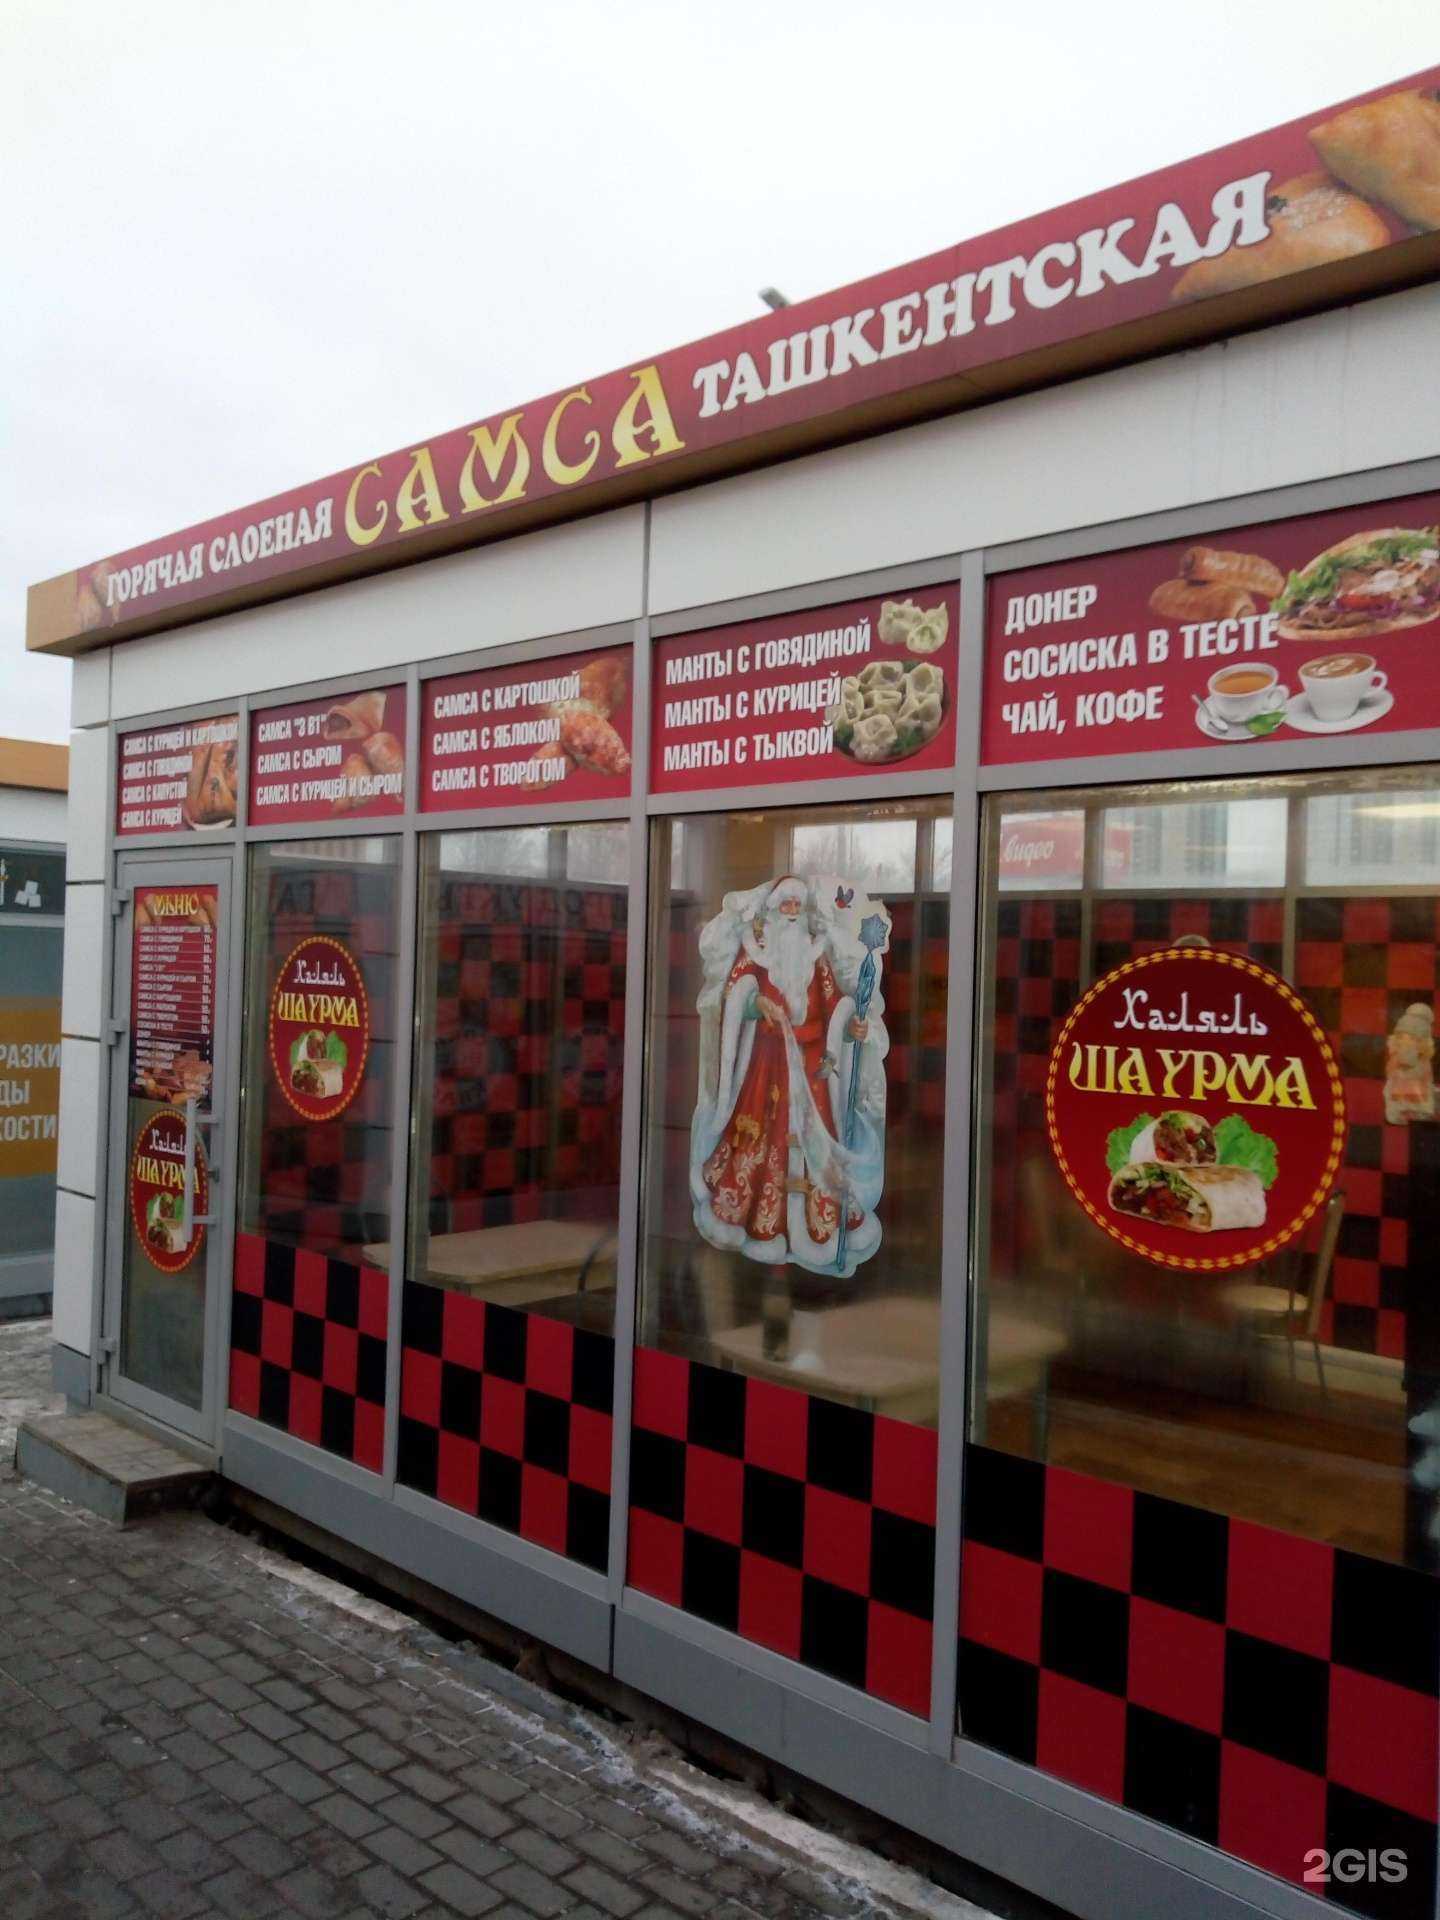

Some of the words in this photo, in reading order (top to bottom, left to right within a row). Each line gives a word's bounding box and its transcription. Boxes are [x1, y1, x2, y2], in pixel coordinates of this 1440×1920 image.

[106, 543, 203, 607] ГОРЯЧАЯ
[209, 498, 333, 573] СЛОЕНАЯ
[345, 364, 685, 546] САМСА
[692, 171, 1271, 418] ТАШКЕНТСКАЯ
[1004, 584, 1098, 635] ДОНЕР
[665, 649, 732, 685] МАНТЫ
[737, 645, 750, 673] С
[755, 617, 871, 670] ГОВЯДИНОЙ
[1003, 631, 1137, 683] СОСИСКА
[1148, 628, 1170, 664] В
[1179, 610, 1279, 659] ТЕСТЕ
[434, 690, 478, 719] САМСА
[482, 688, 491, 712] С
[494, 669, 581, 709] КАРТОШКОЙ
[665, 693, 731, 728] МАНТЫ
[736, 690, 748, 719] С
[754, 670, 842, 717] КУРИЦЕЙ
[1001, 691, 1067, 735] ЧАЙ,
[1075, 685, 1164, 727] КОФЕ
[258, 719, 292, 743] САМСА
[433, 728, 477, 756] САМСА
[481, 726, 490, 750] С
[493, 717, 561, 749] ЯБЛОКОМ
[664, 738, 729, 772] МАНТЫ
[735, 735, 746, 764] С
[752, 720, 834, 762] ТЫКВОЙ
[257, 750, 291, 774] САМСА
[293, 751, 301, 770] С
[301, 744, 342, 769] СЫРОМ
[432, 766, 476, 792] САМСА
[480, 764, 489, 787] С
[492, 757, 566, 787] ТВОРОГОМ
[256, 782, 290, 806] САМСА
[292, 783, 300, 802] С
[301, 773, 347, 802] КУРИЦЕЙ
[358, 773, 402, 797] СЫРОМ
[278, 991, 360, 1028] ШАУРМА
[1113, 987, 1268, 1036] Халяль
[1069, 1041, 1318, 1110] ШАУРМА
[0, 1114, 57, 1141] ОСТИ
